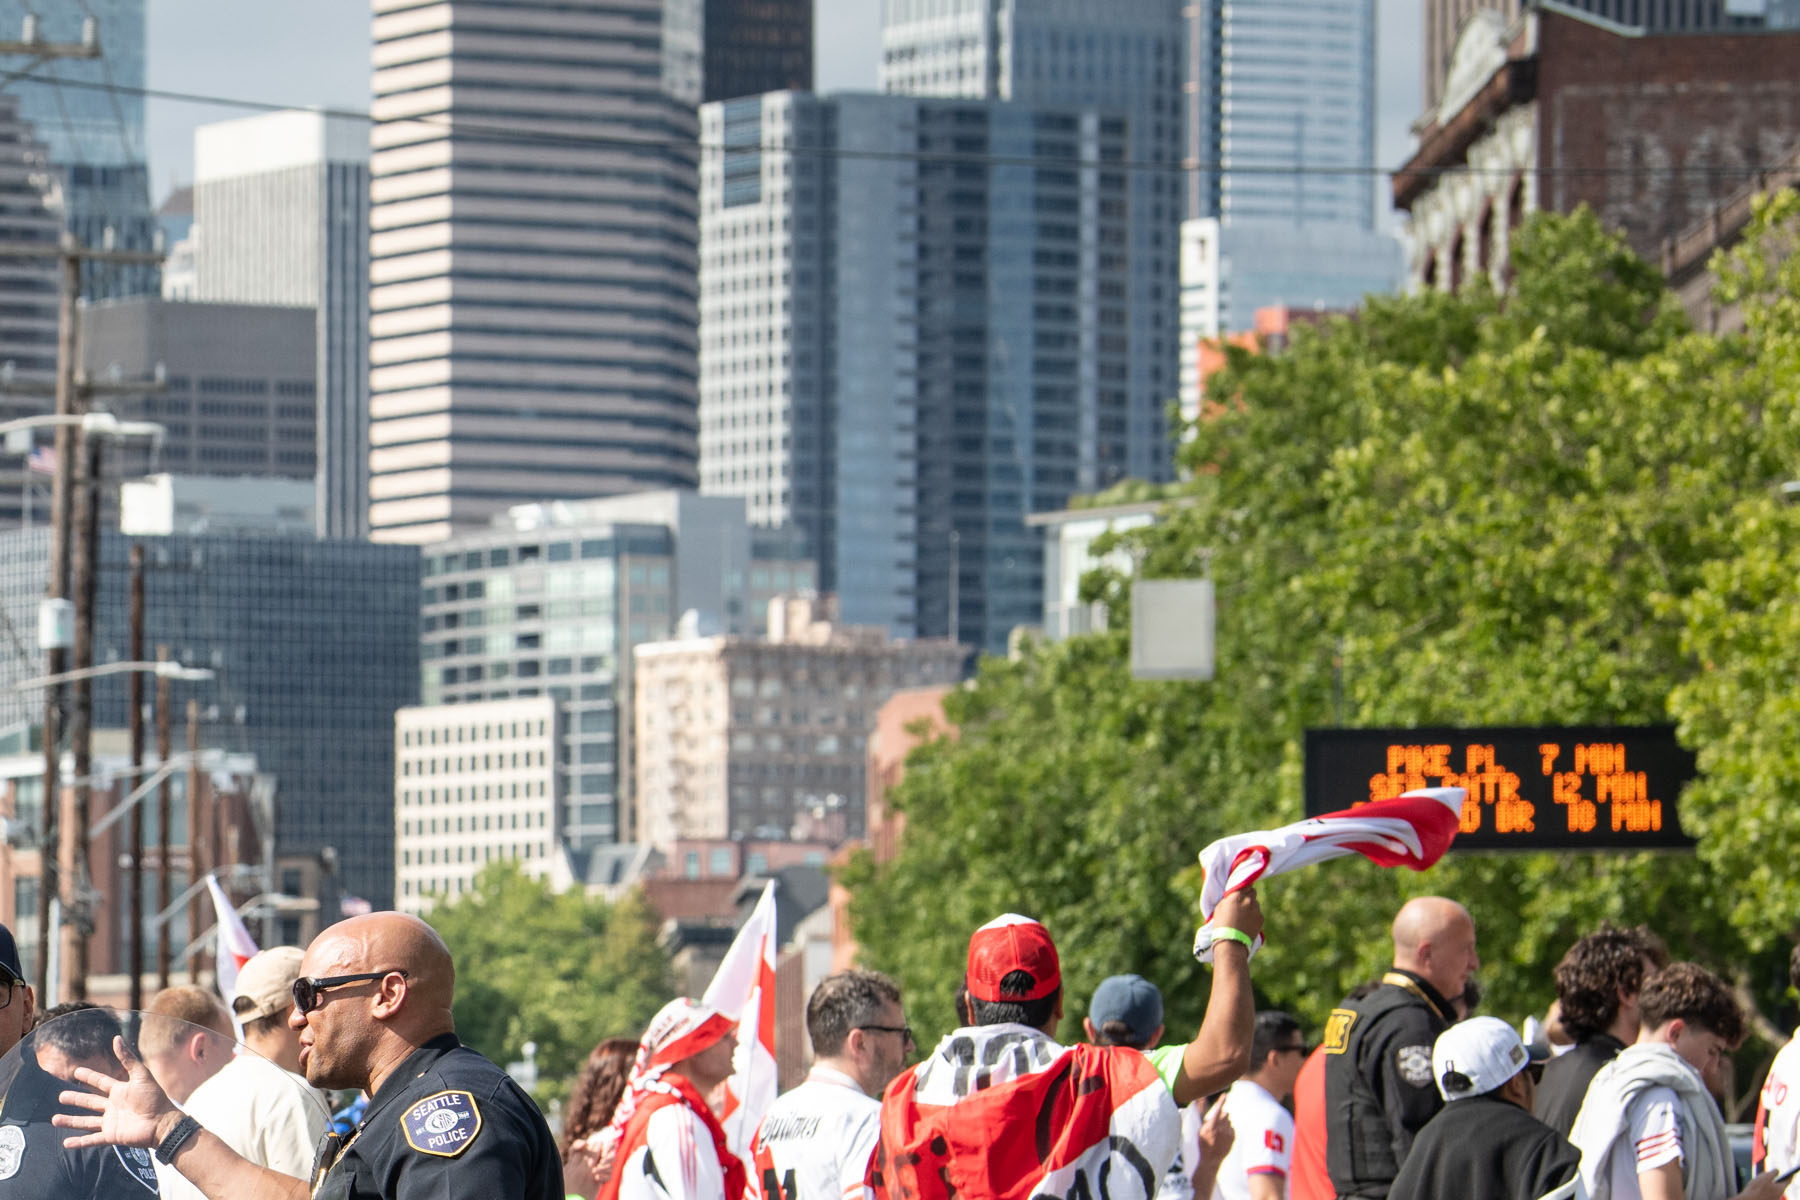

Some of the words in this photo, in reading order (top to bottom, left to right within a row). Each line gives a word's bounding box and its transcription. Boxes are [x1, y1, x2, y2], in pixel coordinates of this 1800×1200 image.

[1539, 743, 1560, 775] 7
[1574, 742, 1626, 775] MIN
[1553, 771, 1582, 804] 12
[1596, 770, 1647, 804] MIN
[1610, 799, 1663, 832] MIN
[412, 1094, 462, 1121] SEATTLE
[427, 1128, 468, 1149] POLICE
